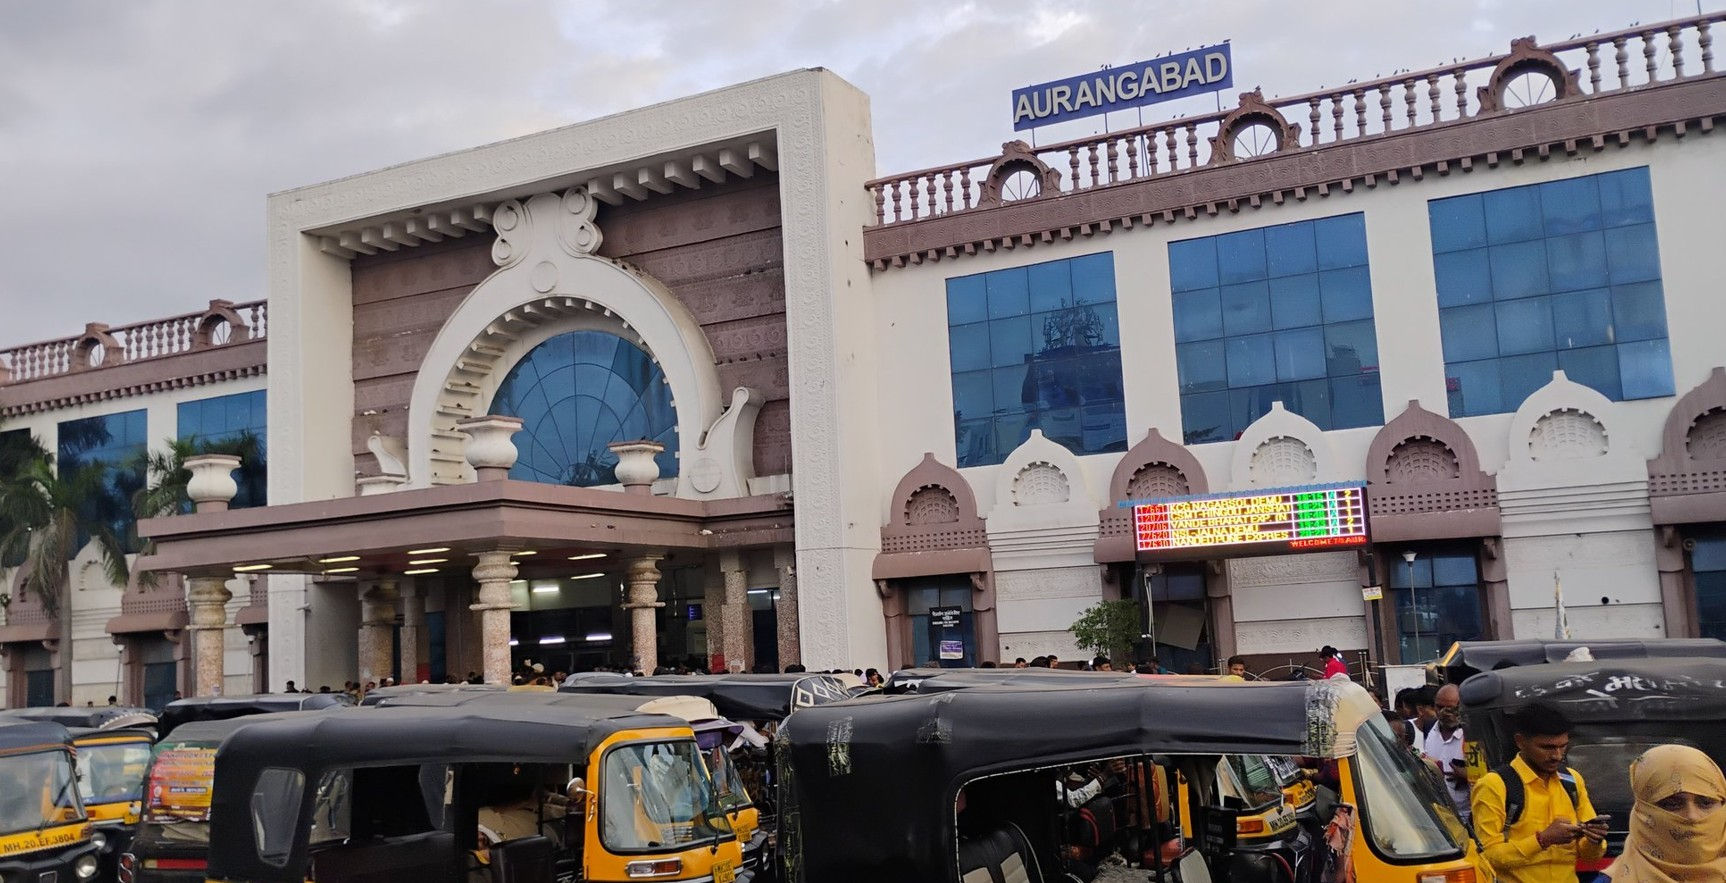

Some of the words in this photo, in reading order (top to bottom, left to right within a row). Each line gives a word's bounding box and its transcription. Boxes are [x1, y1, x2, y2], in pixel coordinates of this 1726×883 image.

[1014, 52, 1228, 123] AURANGABAD
[1172, 519, 1208, 529] VANDE
[1208, 516, 1247, 526] BHARAT
[1230, 524, 1258, 534] DEMU
